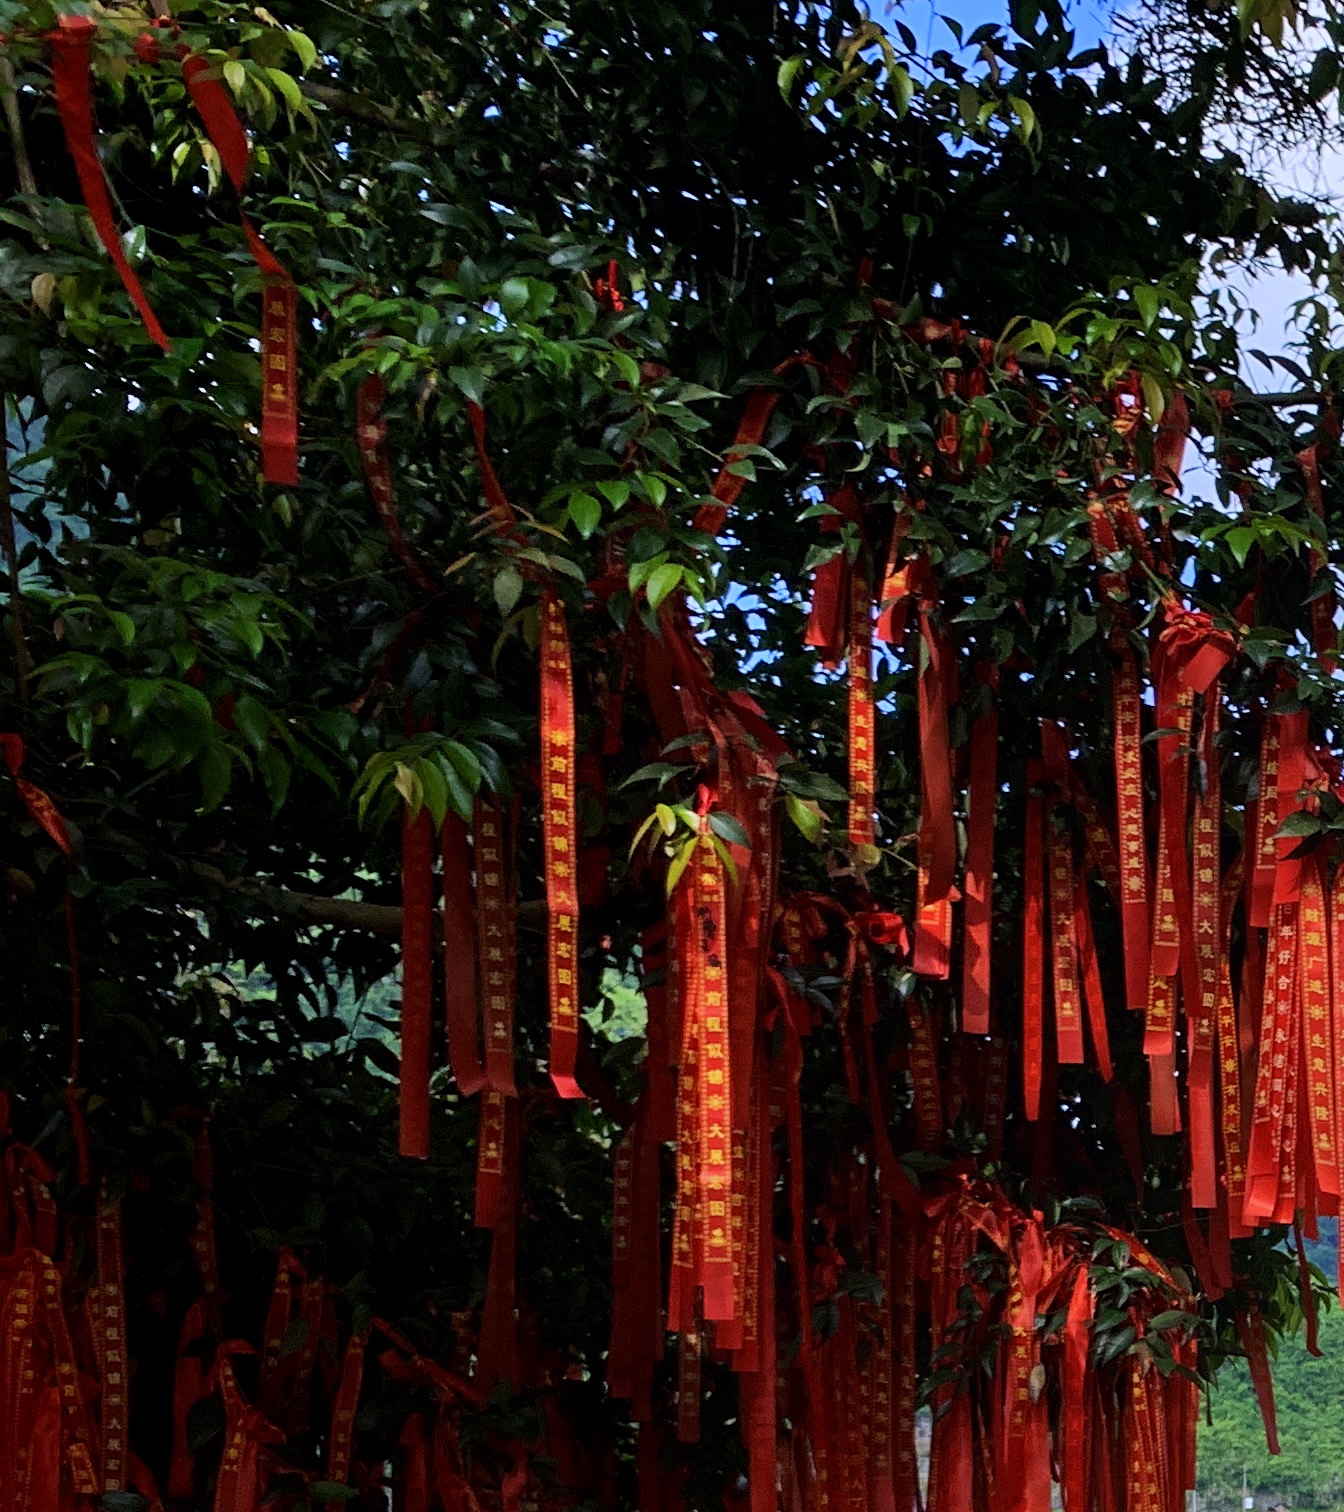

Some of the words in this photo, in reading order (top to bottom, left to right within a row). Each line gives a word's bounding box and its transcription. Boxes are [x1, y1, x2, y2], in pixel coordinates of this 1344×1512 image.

[1305, 908, 1324, 994] 财源广进
[1310, 1034, 1329, 1120] 生意兴隆
